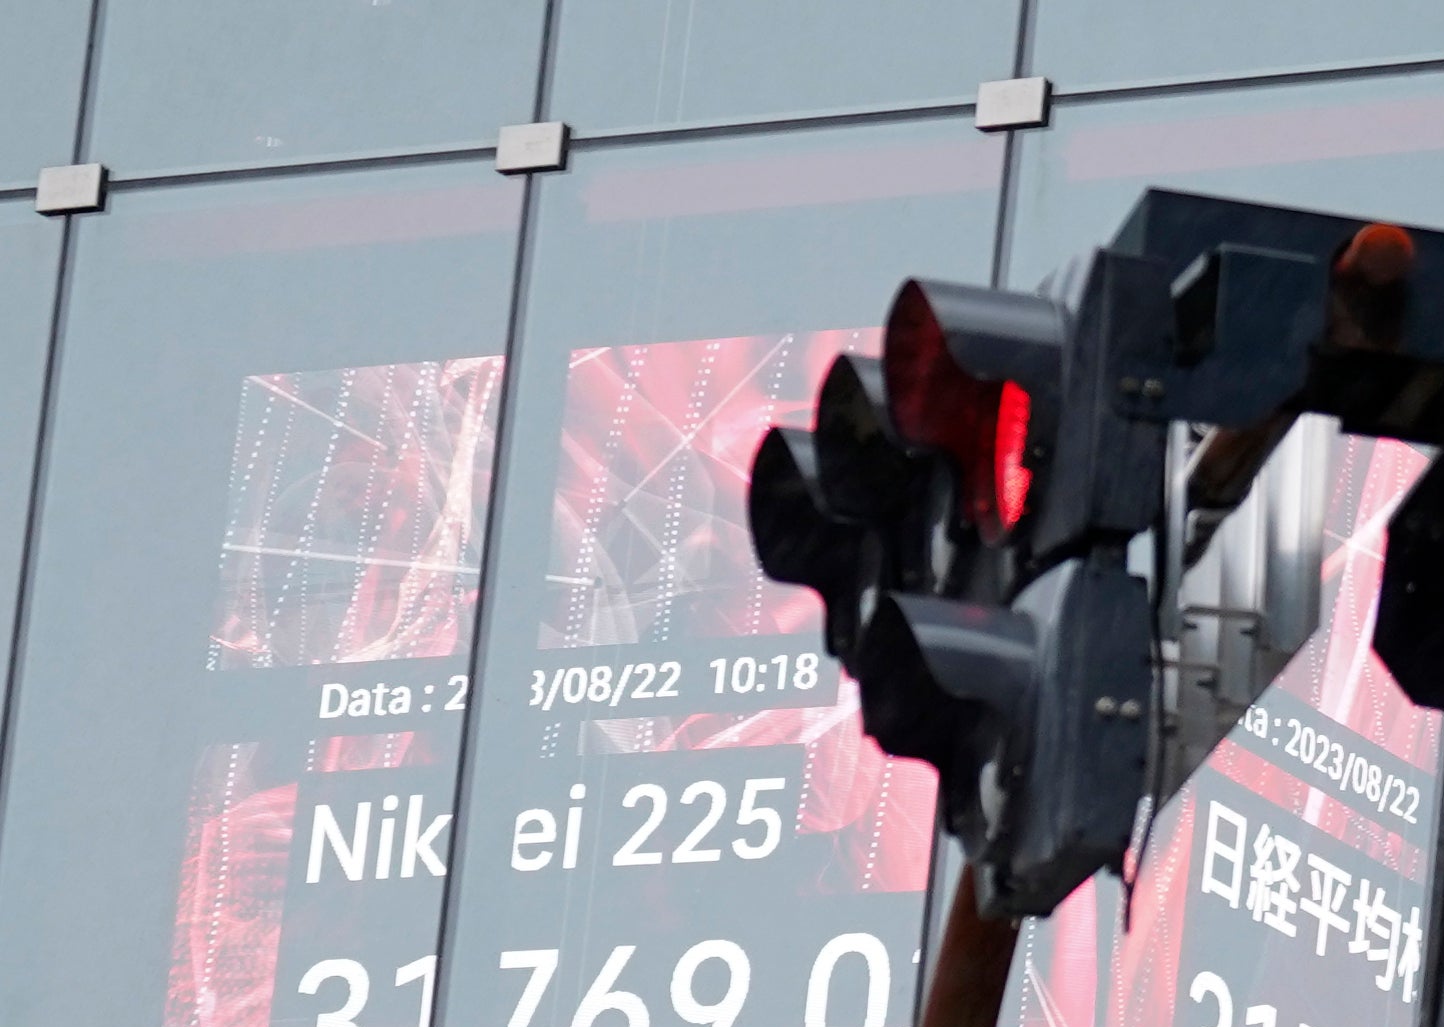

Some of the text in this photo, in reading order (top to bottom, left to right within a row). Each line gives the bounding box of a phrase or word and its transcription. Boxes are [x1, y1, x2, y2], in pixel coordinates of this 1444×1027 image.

[318, 682, 412, 719] Data
[443, 661, 682, 711] 23/08/22
[709, 652, 819, 694] 10:18
[1284, 718, 1420, 824] 2023/08/22
[305, 777, 786, 884] Nikei 225
